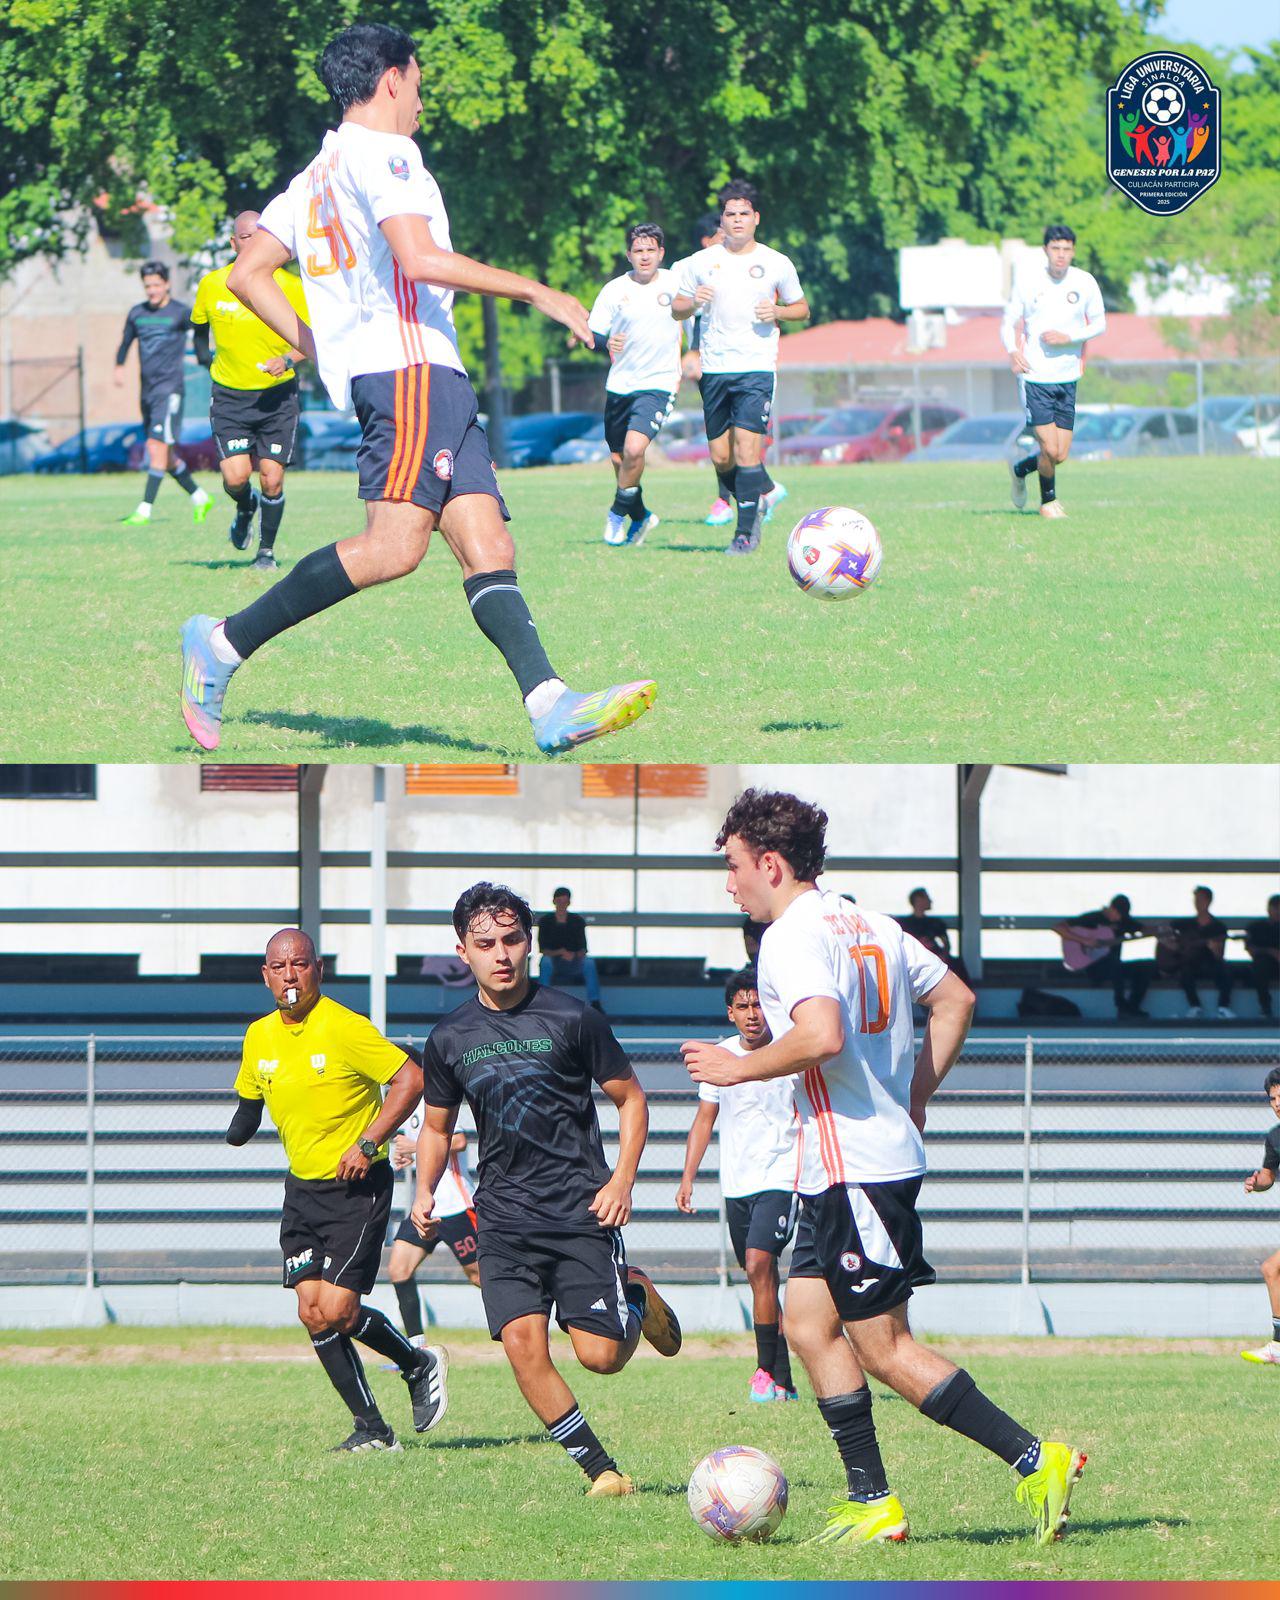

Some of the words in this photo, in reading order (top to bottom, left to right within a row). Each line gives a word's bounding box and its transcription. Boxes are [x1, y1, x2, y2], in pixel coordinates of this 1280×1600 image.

[462, 1038, 553, 1067] HALCONES
[453, 1234, 477, 1258] 50
[285, 1247, 314, 1273] FMF
